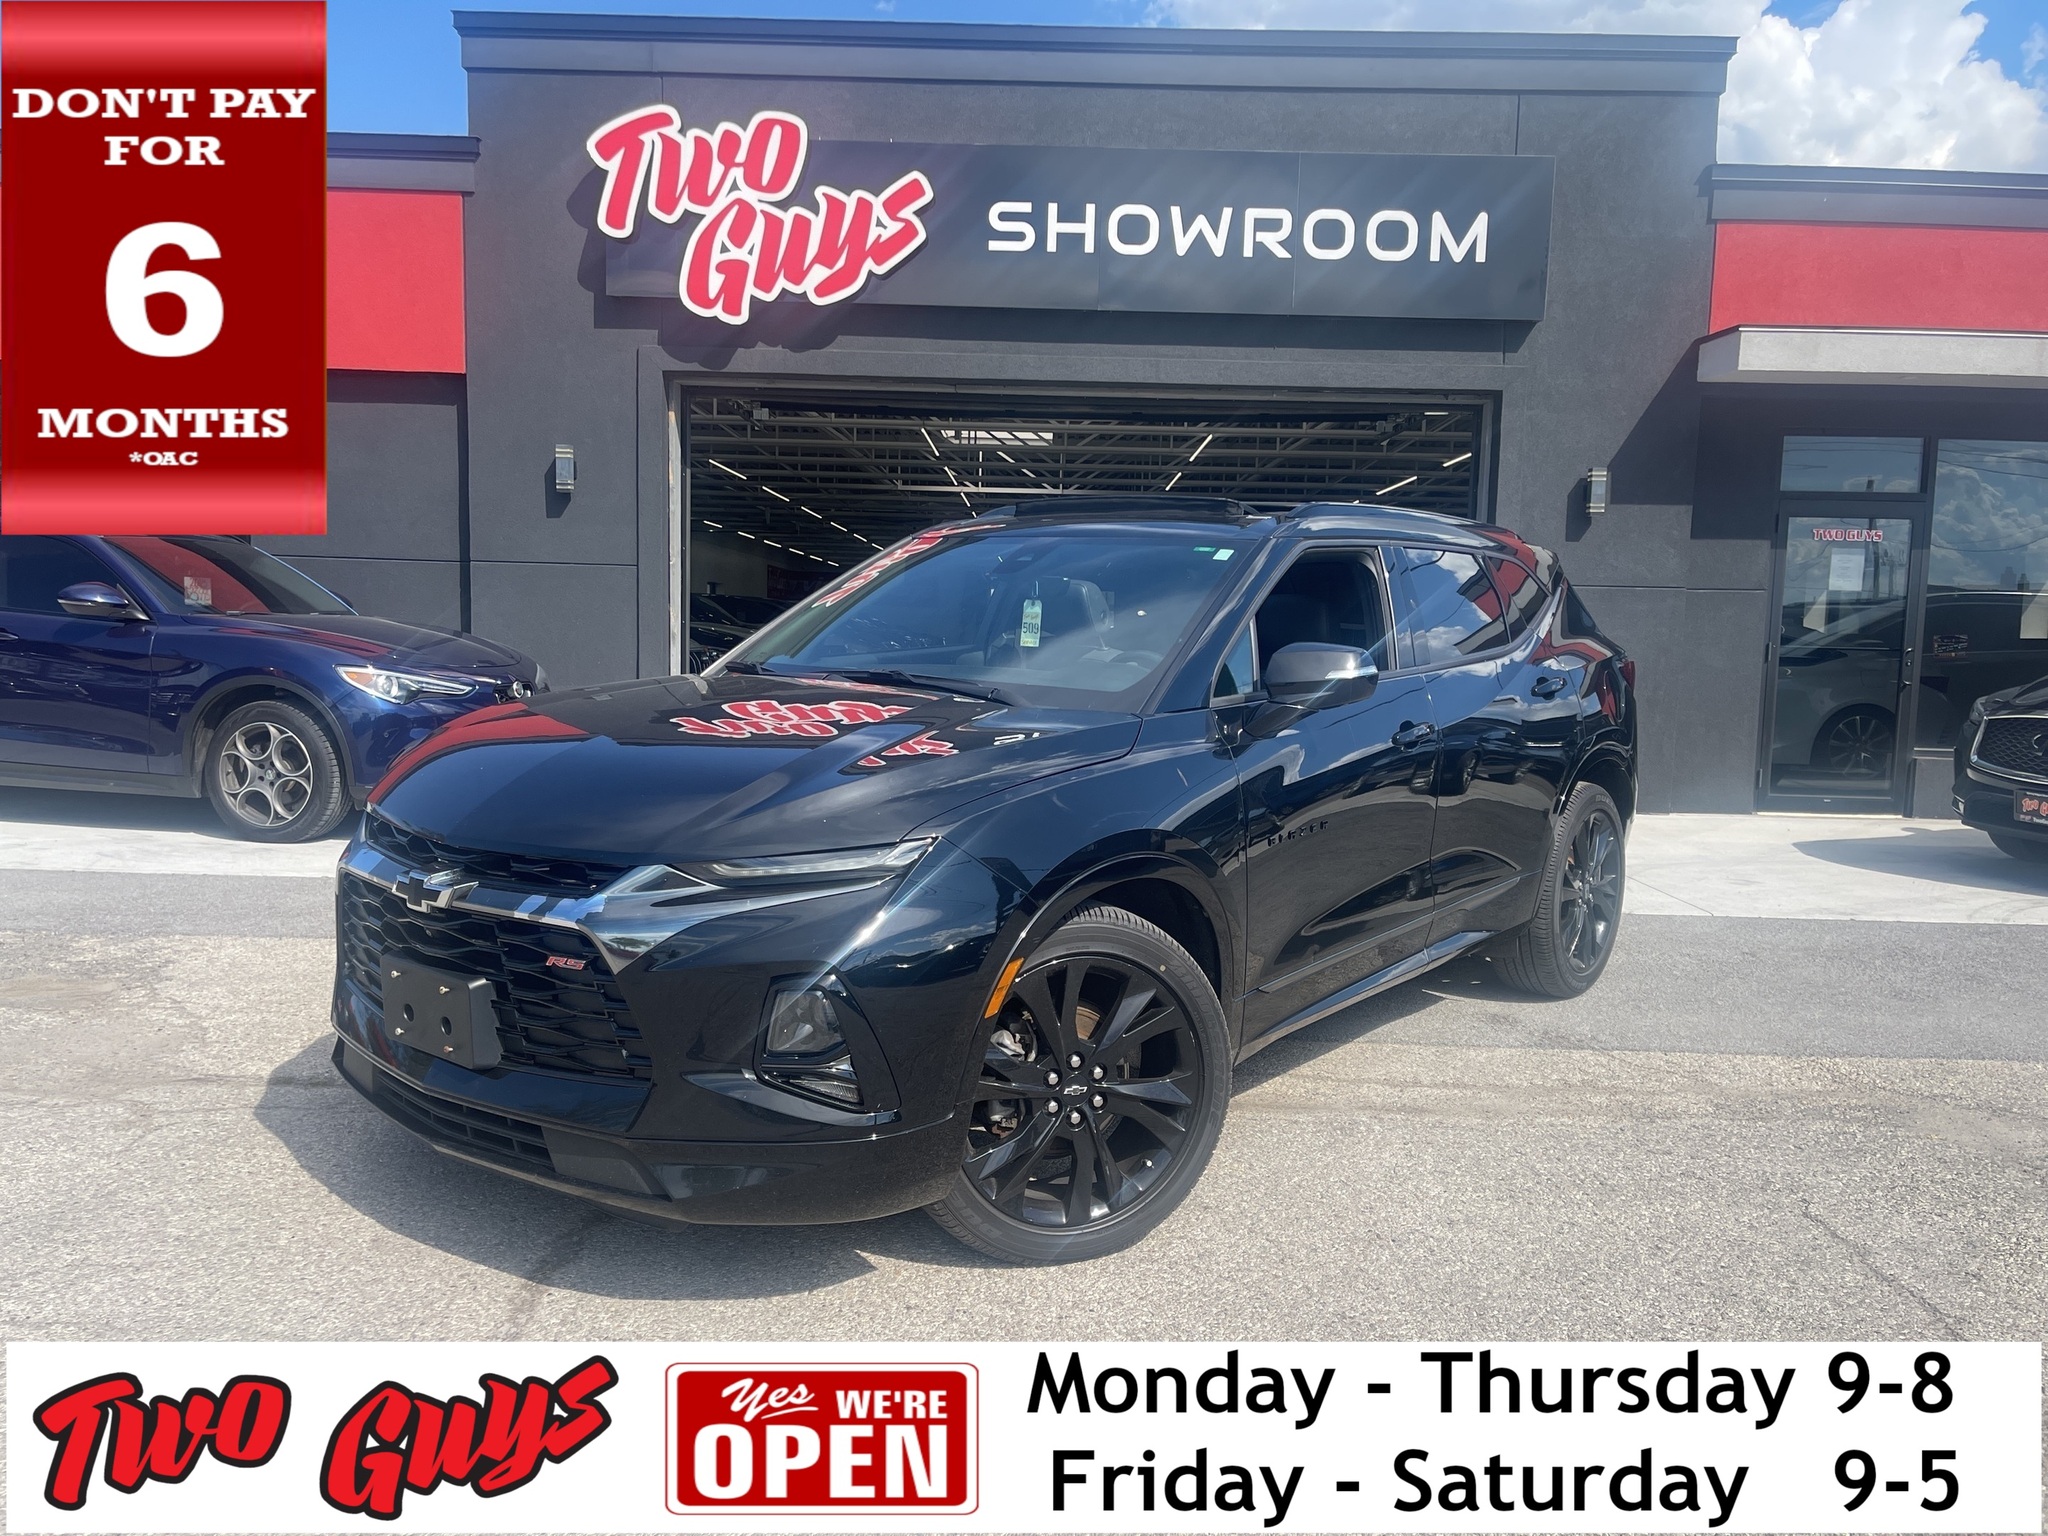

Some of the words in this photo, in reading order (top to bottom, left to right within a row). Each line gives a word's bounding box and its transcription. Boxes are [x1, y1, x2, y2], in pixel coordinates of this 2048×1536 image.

[586, 104, 808, 238] Two
[679, 170, 934, 325] Guys
[987, 200, 1490, 264] SHOWROOM
[1813, 528, 1845, 541] TWO
[1846, 529, 1883, 542] GUYS
[1022, 622, 1039, 634] 509
[545, 955, 587, 971] RS
